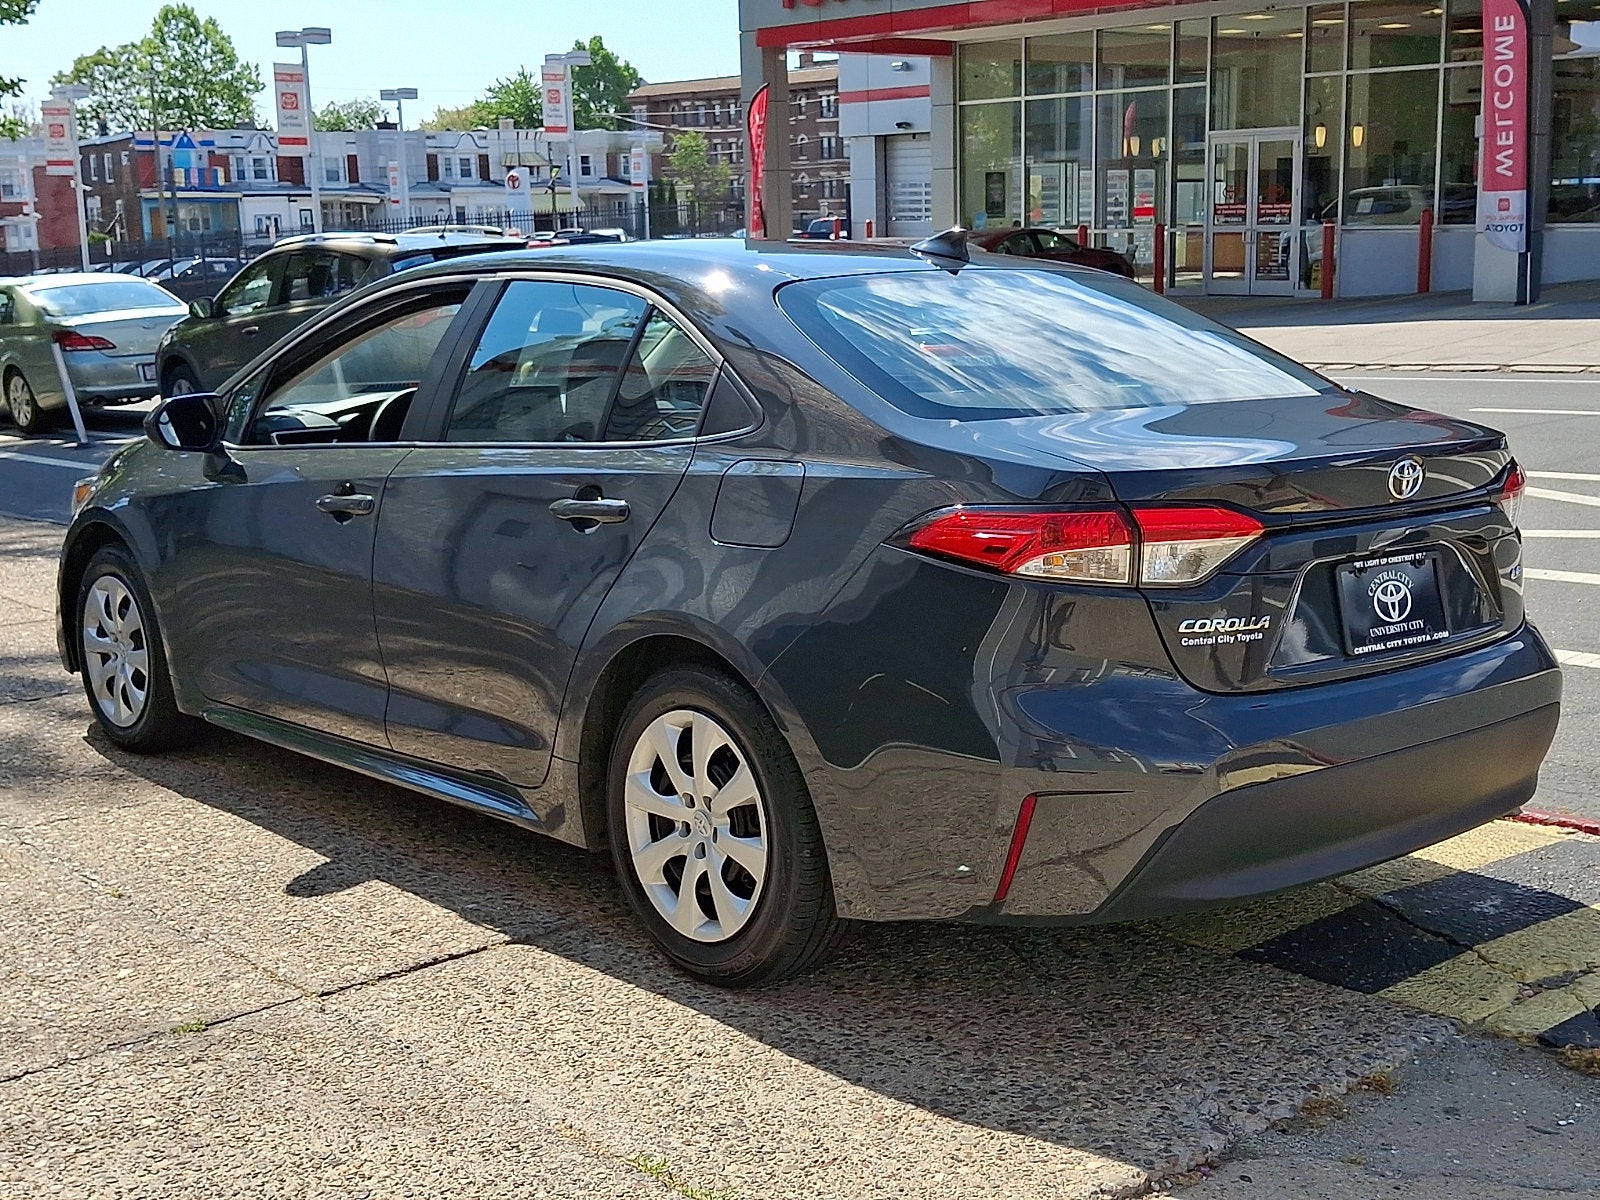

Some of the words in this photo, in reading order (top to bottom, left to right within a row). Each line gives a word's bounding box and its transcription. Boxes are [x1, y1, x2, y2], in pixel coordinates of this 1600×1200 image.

[1365, 558, 1379, 567] LIGHT
[1380, 557, 1388, 565] UP
[1368, 570, 1396, 597] CENTRAL
[1397, 571, 1415, 589] CITY
[1178, 615, 1271, 633] COROLLA
[1369, 622, 1408, 637] UNIVERSITY
[1408, 619, 1425, 630] CITY
[1181, 636, 1216, 646] Central
[1217, 635, 1235, 644] City
[1236, 632, 1263, 642] Toyota
[1354, 643, 1386, 655] CENTRAL
[1386, 639, 1402, 649] CITY
[1402, 634, 1431, 646] TOYOTA
[1432, 630, 1450, 640] .COM
